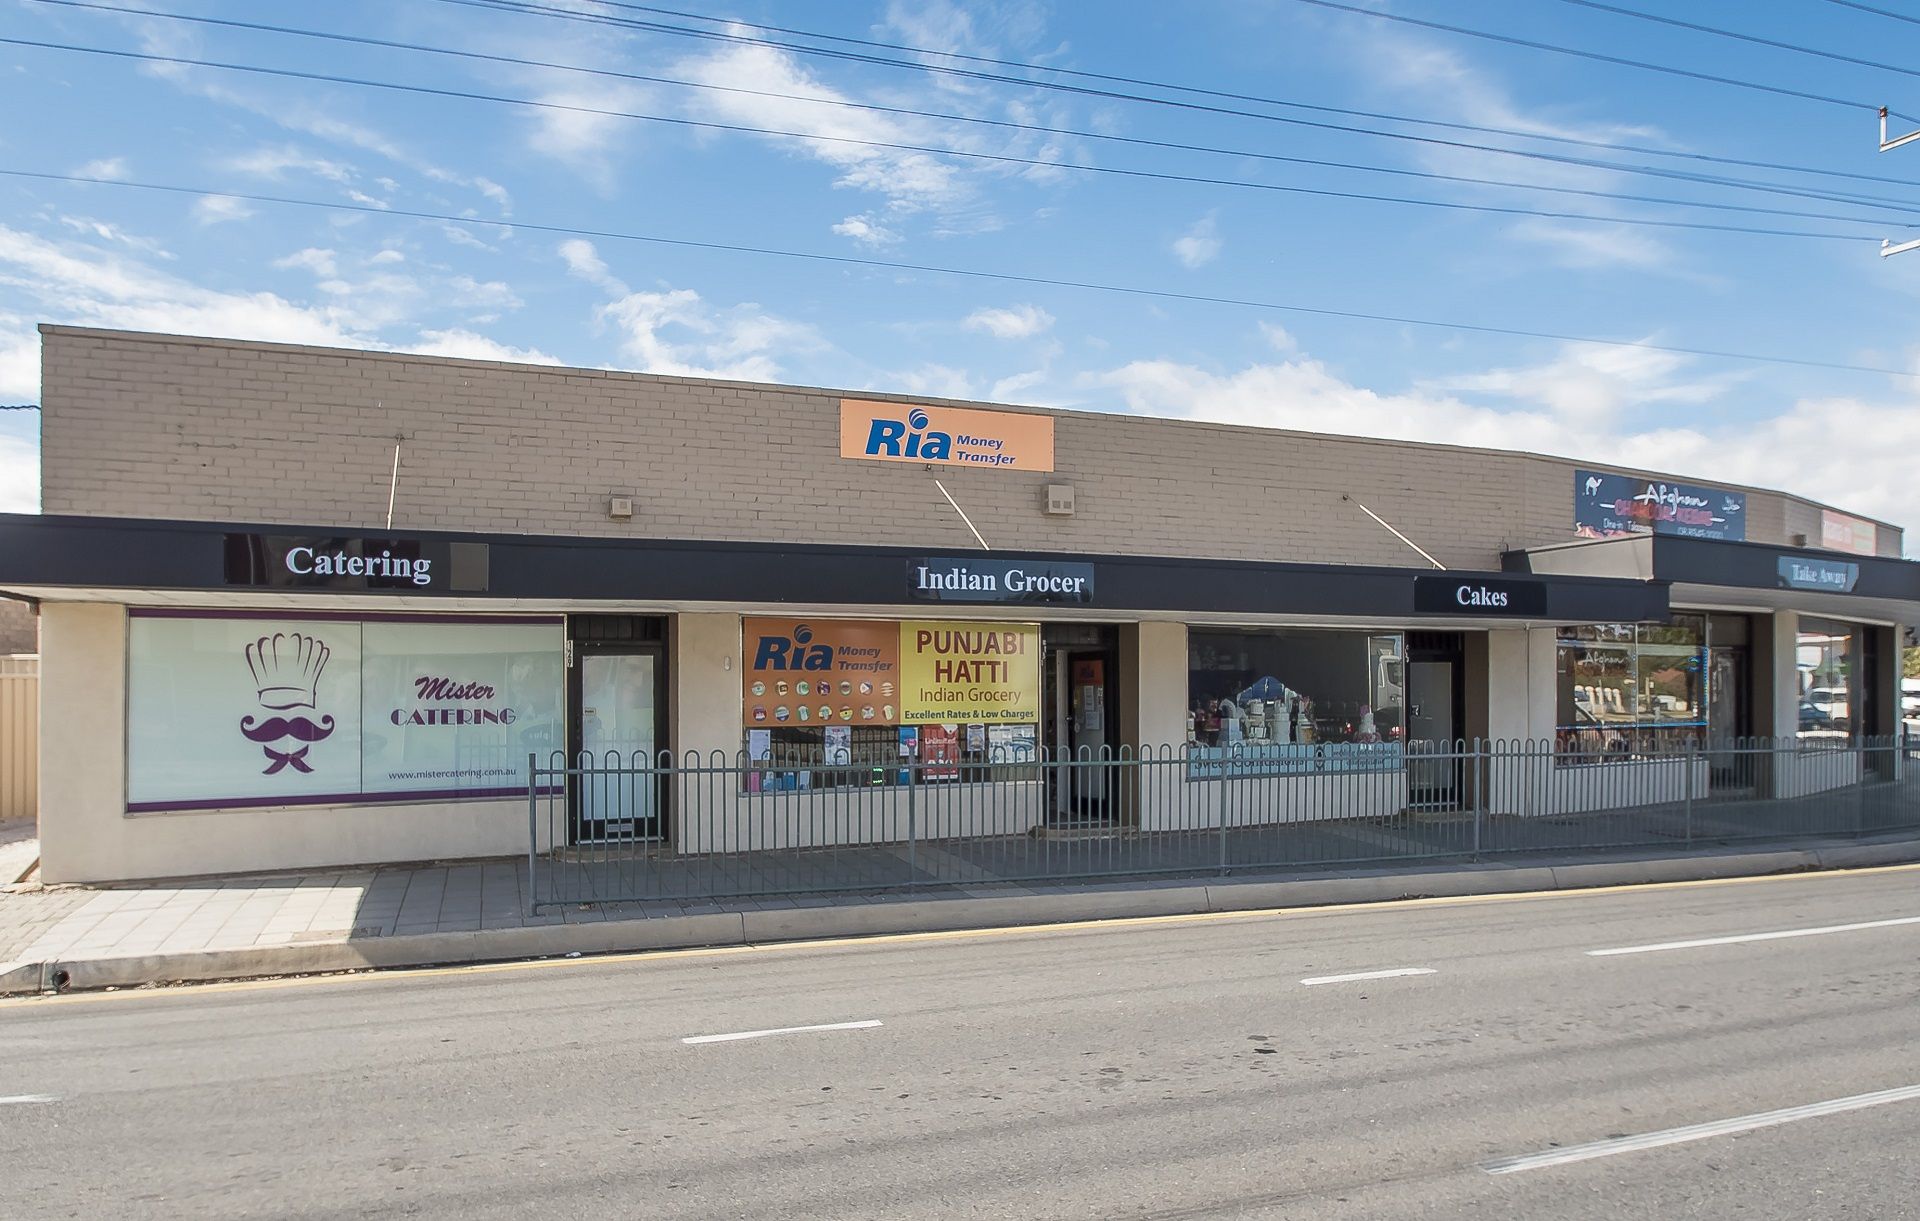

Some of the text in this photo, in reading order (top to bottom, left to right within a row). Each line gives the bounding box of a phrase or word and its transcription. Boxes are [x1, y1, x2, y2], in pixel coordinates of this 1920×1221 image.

[864, 407, 952, 460] Ria
[956, 434, 1004, 450] Money
[956, 450, 1016, 466] Transfer
[1633, 484, 1708, 515] Afghan
[285, 546, 432, 585] Catering
[1791, 563, 1847, 588] Take Away
[917, 566, 1085, 593] Indian Grocer
[1456, 584, 1508, 607] Cakes
[754, 623, 834, 671] Ria
[837, 645, 881, 659] Money
[916, 630, 1025, 656] PUNJABI
[837, 659, 893, 673] Transfer
[934, 659, 1009, 684] HATTI
[1582, 651, 1625, 673] Afghan
[414, 675, 495, 702] Mister
[919, 686, 1022, 705] Indian Grocery
[390, 706, 517, 727] CATERING
[904, 709, 1035, 721] Excellent Rates & Low Charges
[388, 766, 518, 780] www.mistercatering.com.au
